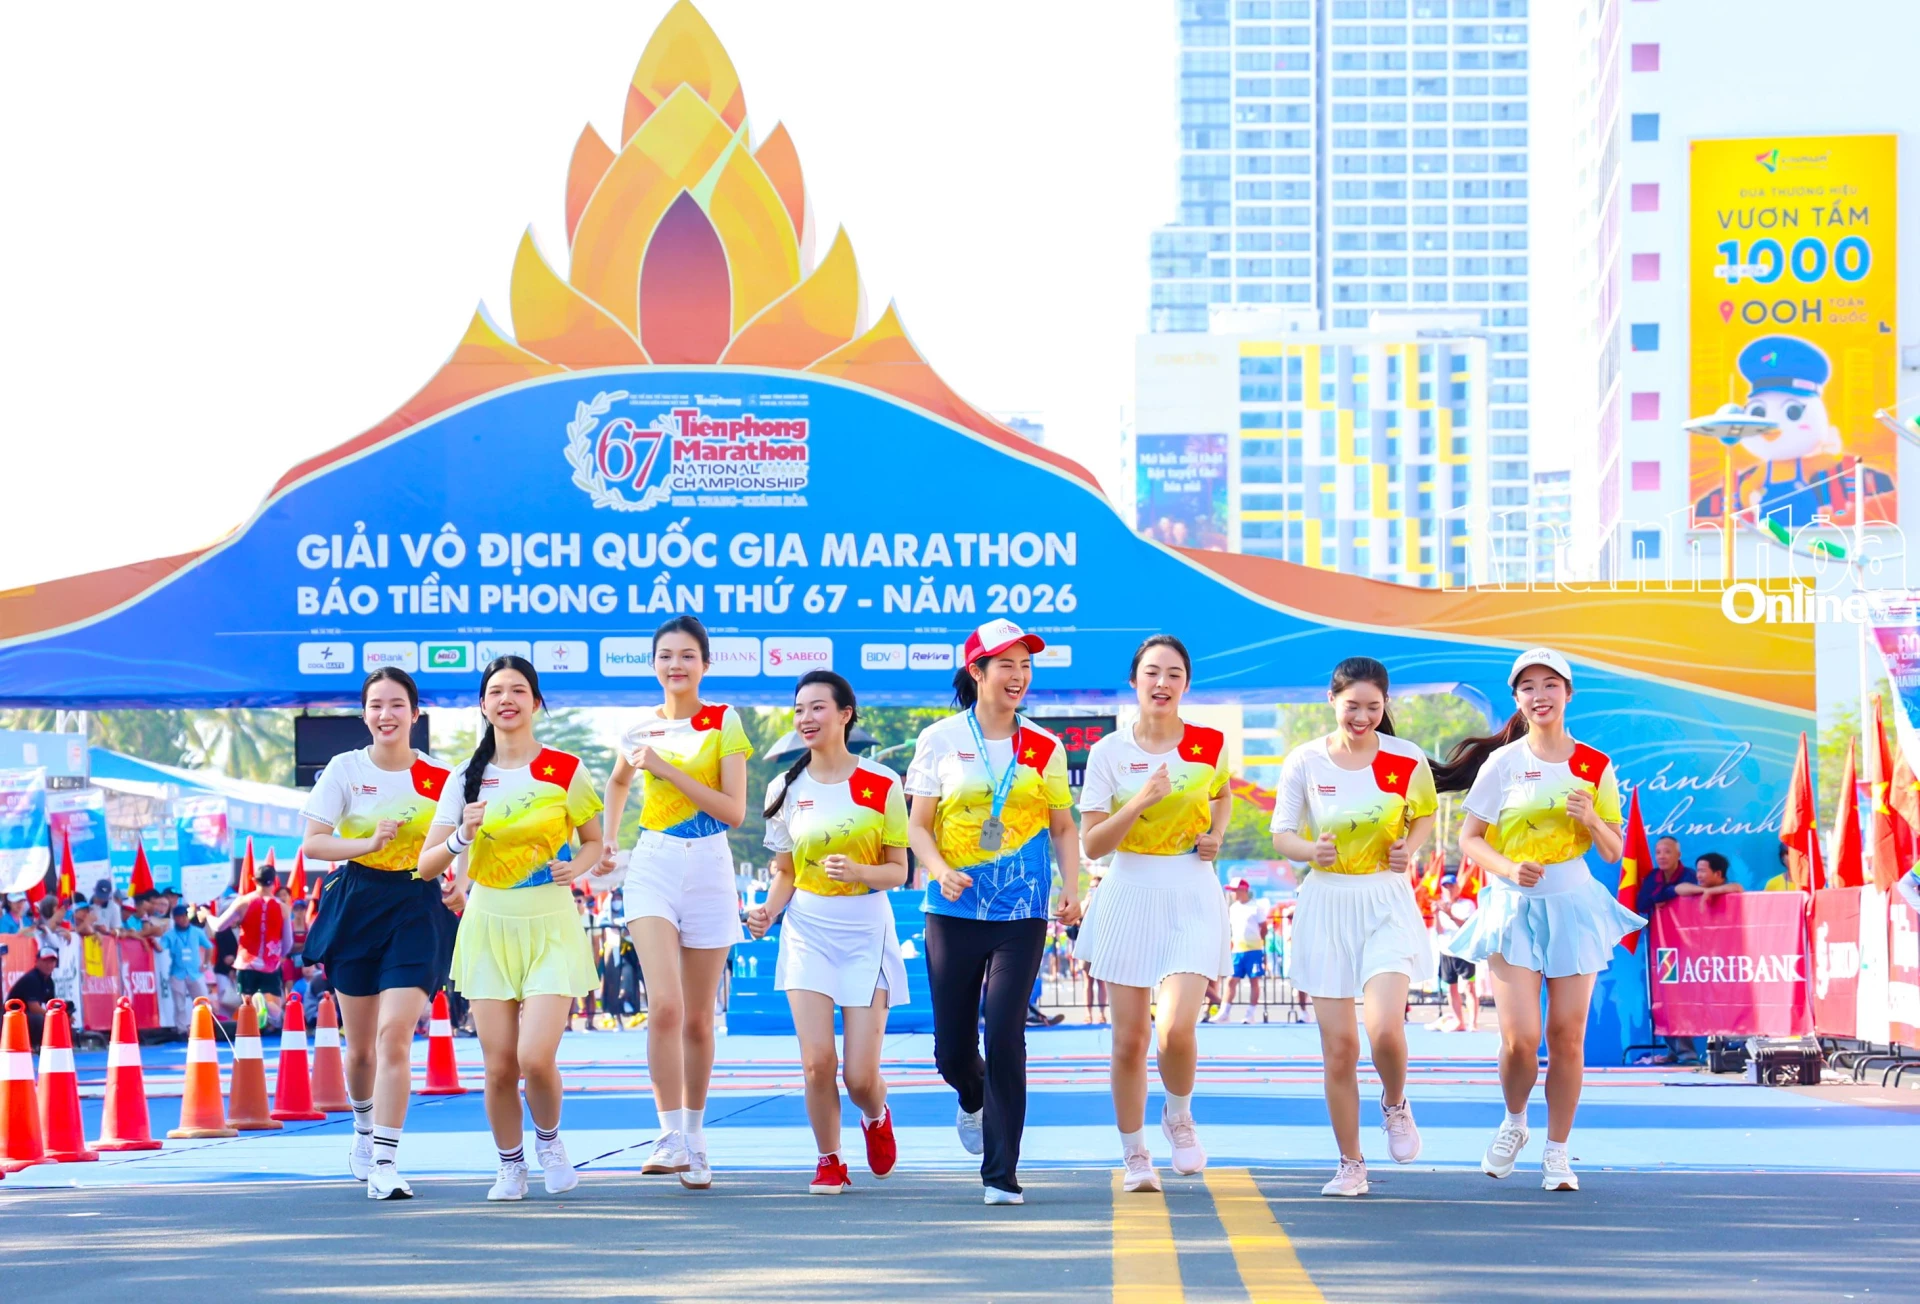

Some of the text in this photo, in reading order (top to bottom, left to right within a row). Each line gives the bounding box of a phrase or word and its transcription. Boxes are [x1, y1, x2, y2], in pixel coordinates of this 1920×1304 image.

[1716, 235, 1872, 284] 1000
[1742, 299, 1822, 325] OOH
[597, 420, 664, 489] 67
[673, 441, 806, 461] Marathon
[673, 463, 760, 475] NATIONAL
[673, 477, 806, 489] CHAMPIONSHIP
[296, 517, 1077, 576] GIẢI VÔ ĐỊCH QUỐC GIA MARATHON
[297, 577, 379, 615] BÁO
[389, 571, 469, 614] TIỀN
[480, 584, 618, 614] PHONG
[628, 571, 704, 614] LẦN
[715, 575, 794, 614] THỨ
[803, 584, 848, 614] 67
[883, 575, 976, 614] NĂM
[986, 584, 1077, 614] 2026
[367, 653, 403, 662] HDBank
[438, 651, 457, 660] MILO
[605, 652, 653, 664] Herbalif
[709, 652, 757, 661] RIBANK
[786, 652, 828, 661] SABECO
[867, 652, 892, 662] BIDV
[1681, 954, 1807, 983] AGRIBANK
